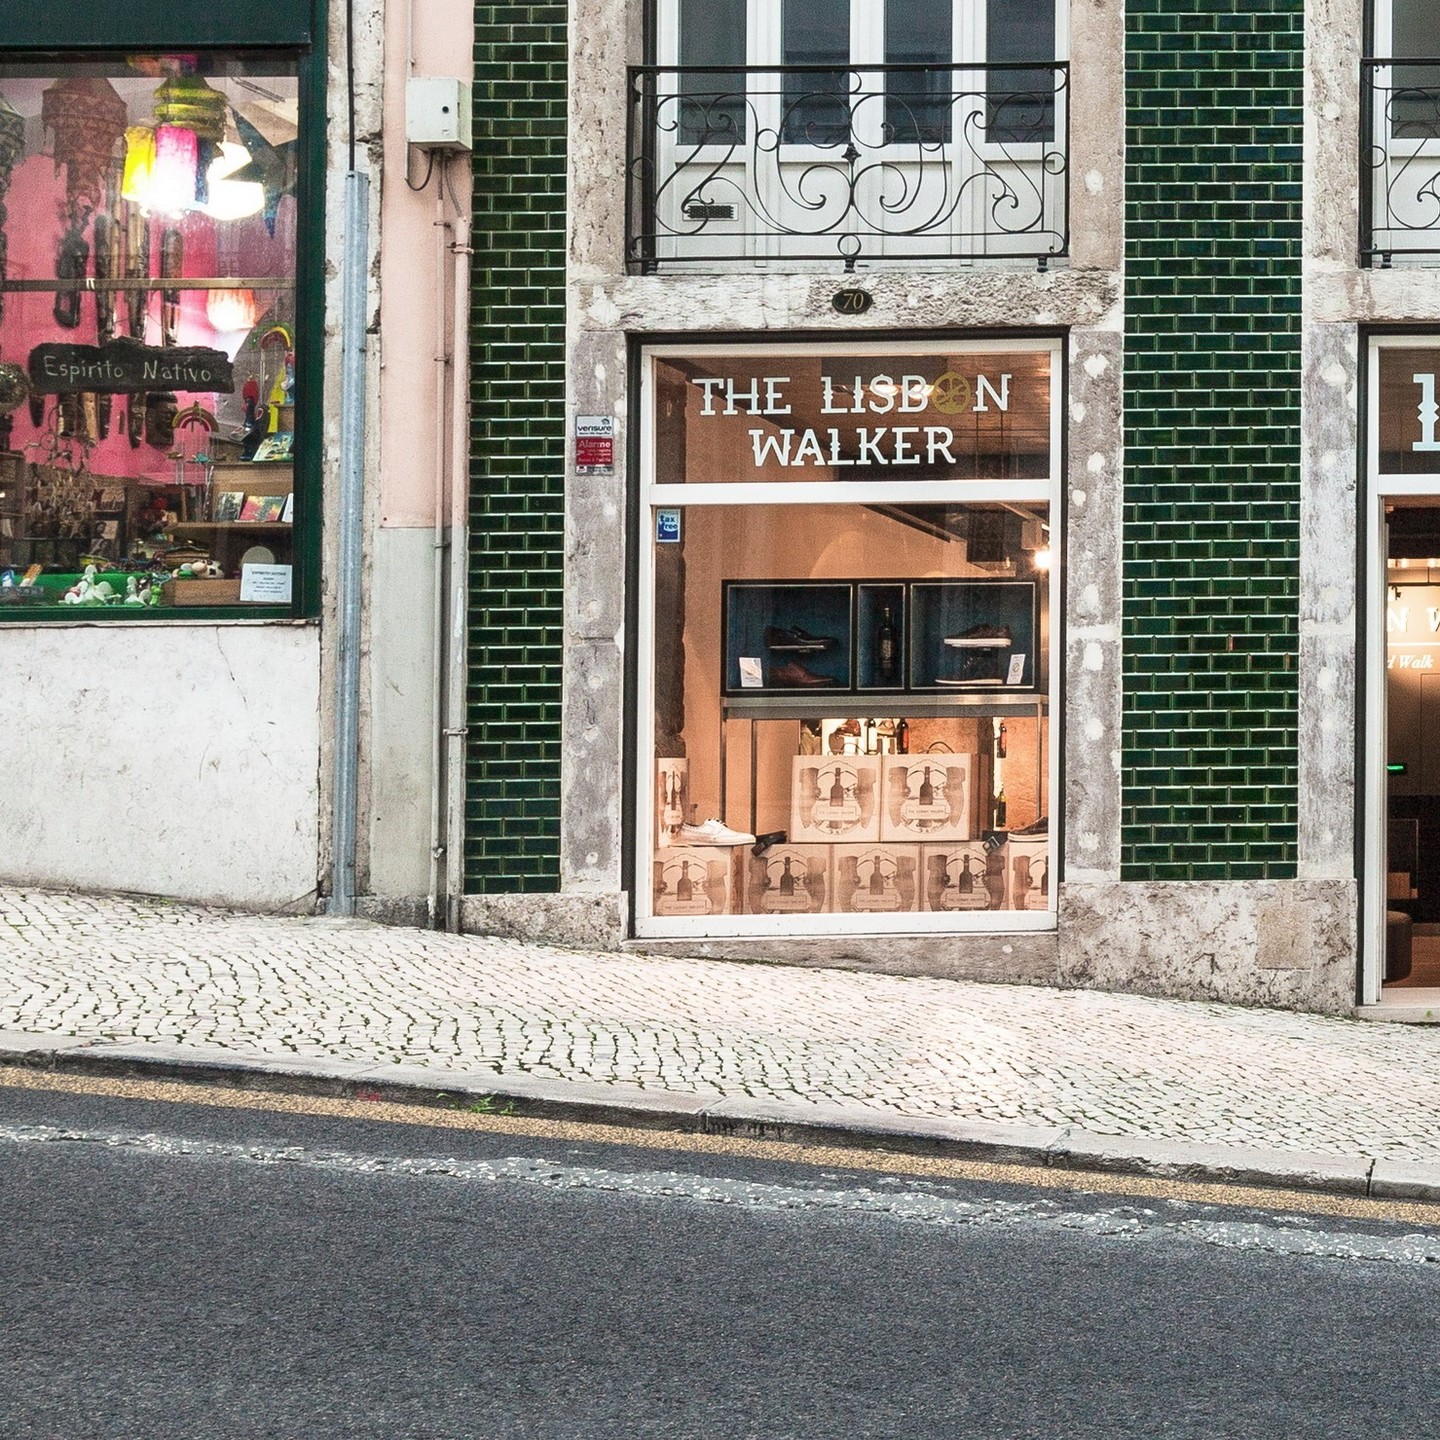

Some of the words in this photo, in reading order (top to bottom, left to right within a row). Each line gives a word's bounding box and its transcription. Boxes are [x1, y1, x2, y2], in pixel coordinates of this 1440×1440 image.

[843, 292, 865, 310] 70
[692, 377, 791, 415] THE
[748, 426, 957, 467] WALKER
[660, 515, 675, 523] tax
[1399, 654, 1434, 669] Walk
